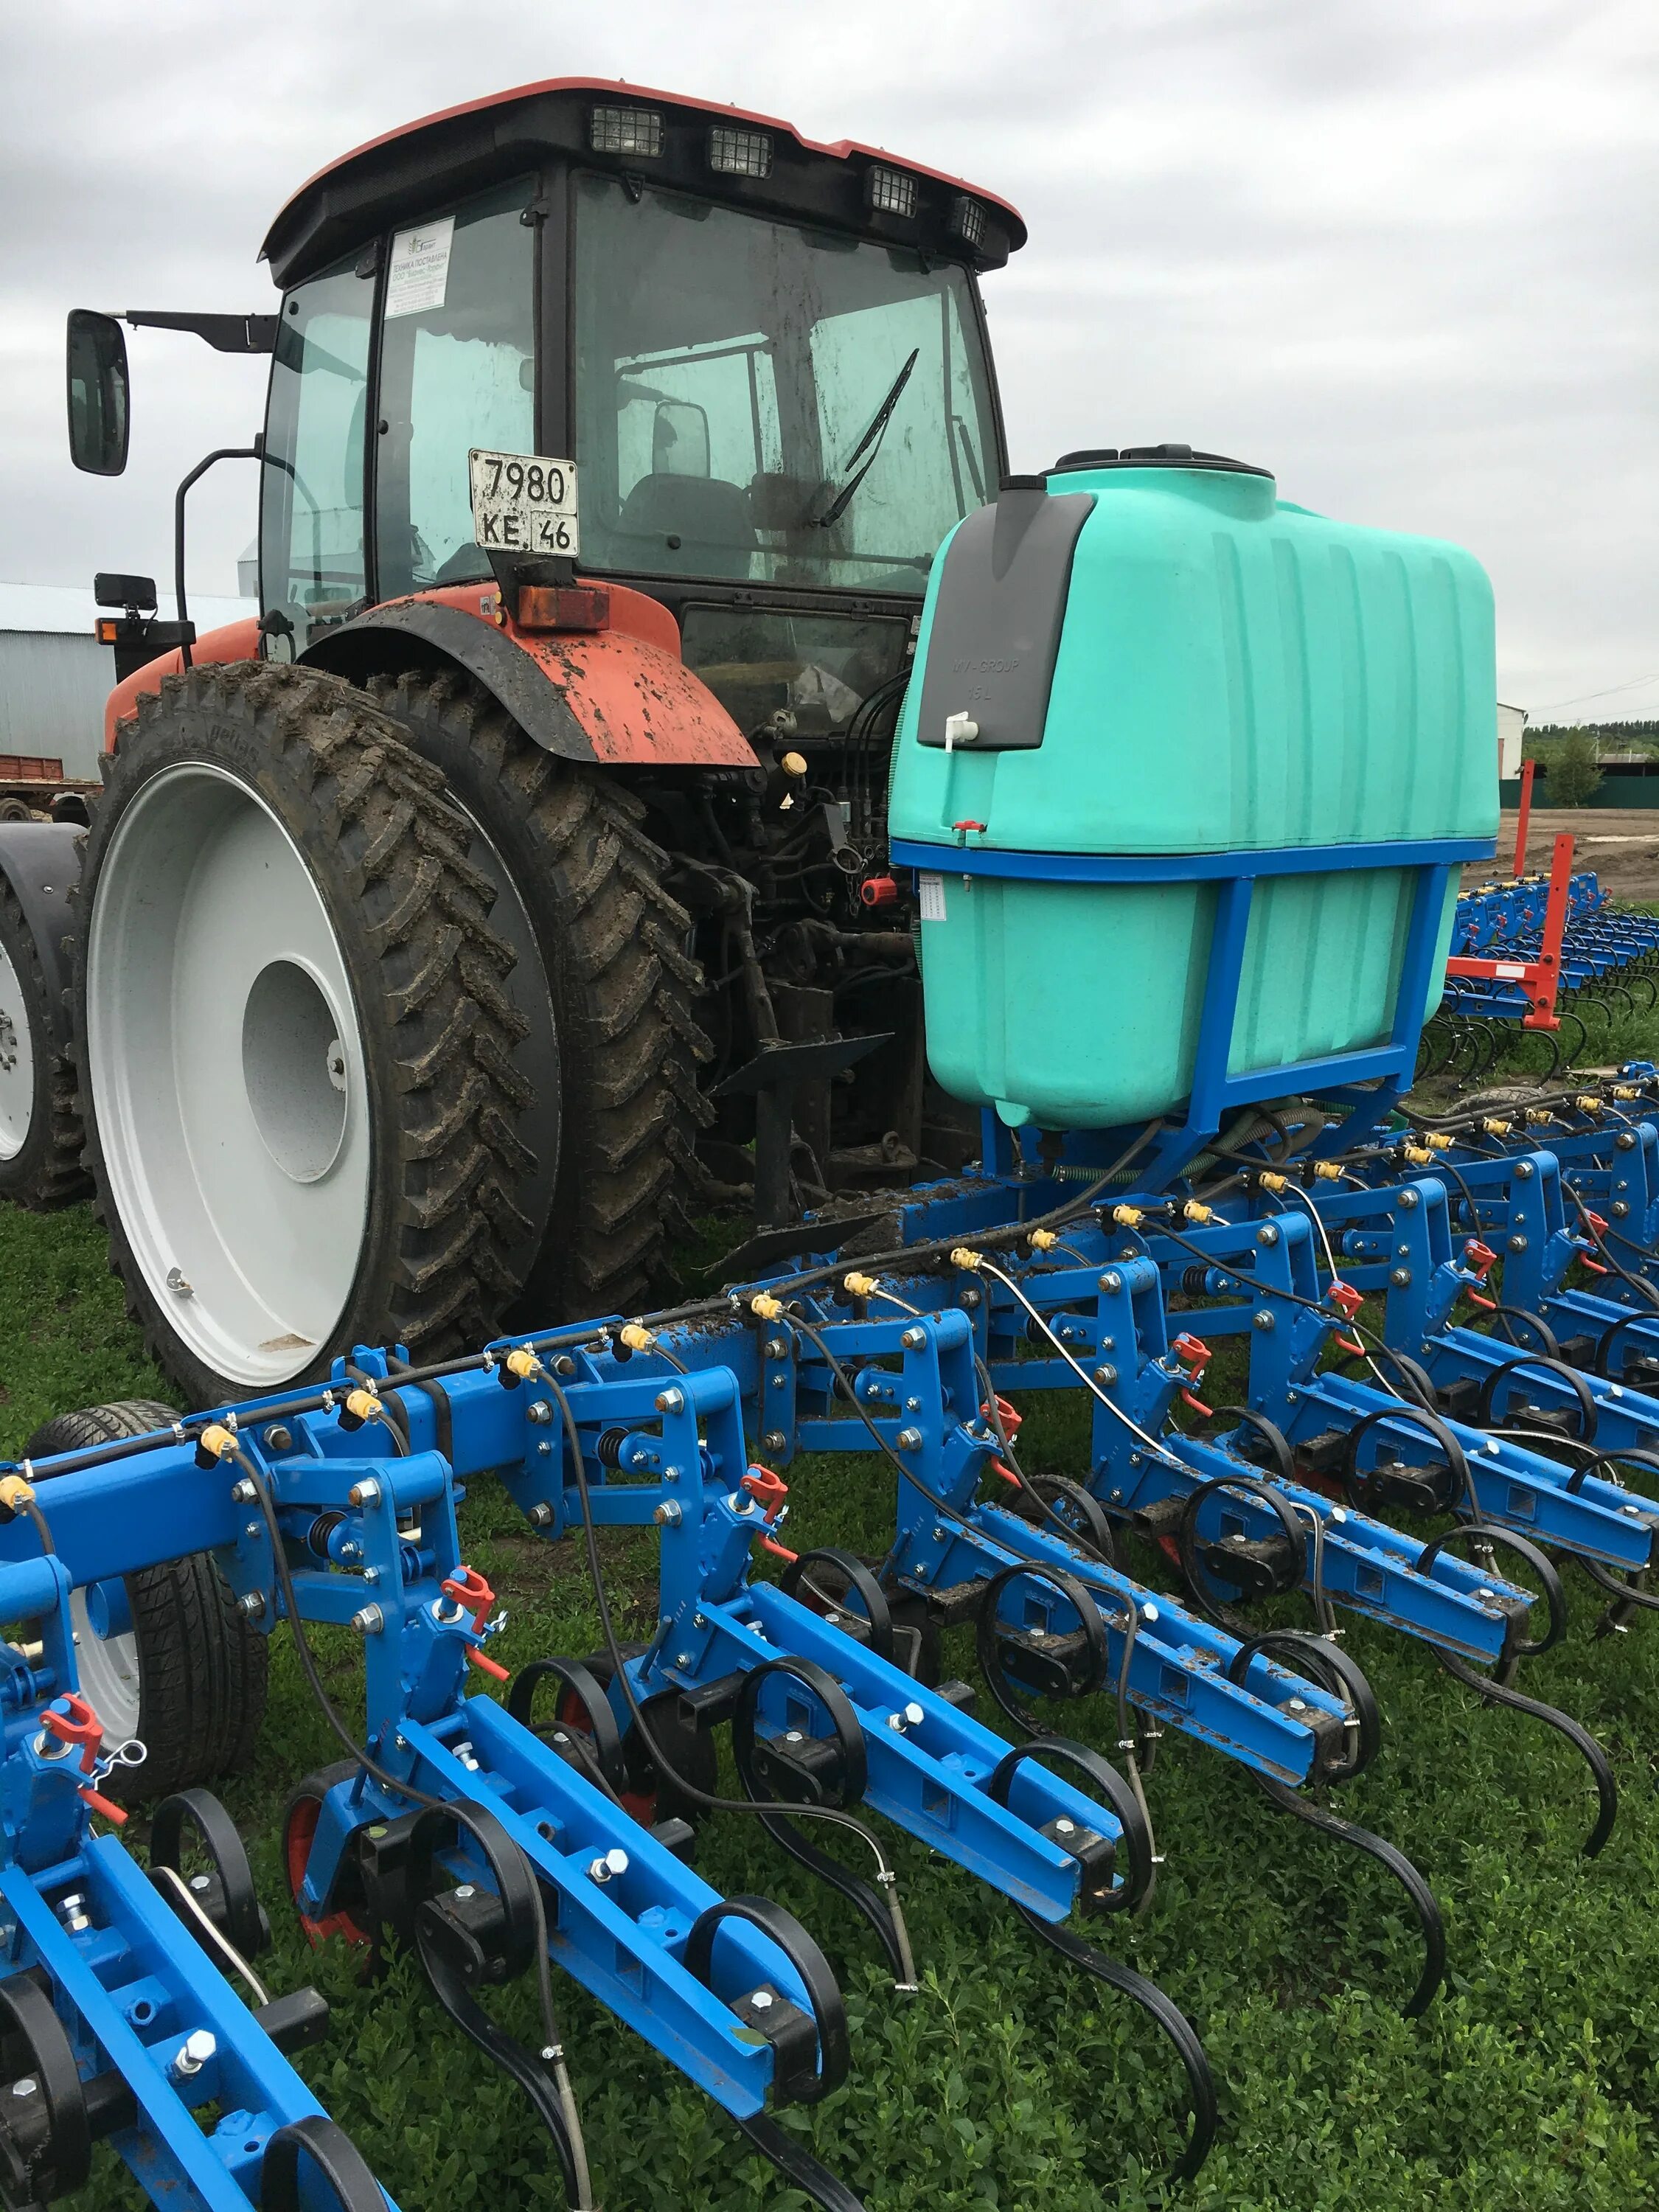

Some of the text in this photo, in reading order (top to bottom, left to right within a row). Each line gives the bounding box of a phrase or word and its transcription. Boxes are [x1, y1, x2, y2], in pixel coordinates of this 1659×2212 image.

[393, 252, 448, 273] ТЕХНИКА ПОСТАВЛЕНА
[392, 271, 405, 282] ООО
[485, 459, 565, 504] 7980
[538, 519, 570, 549] 46
